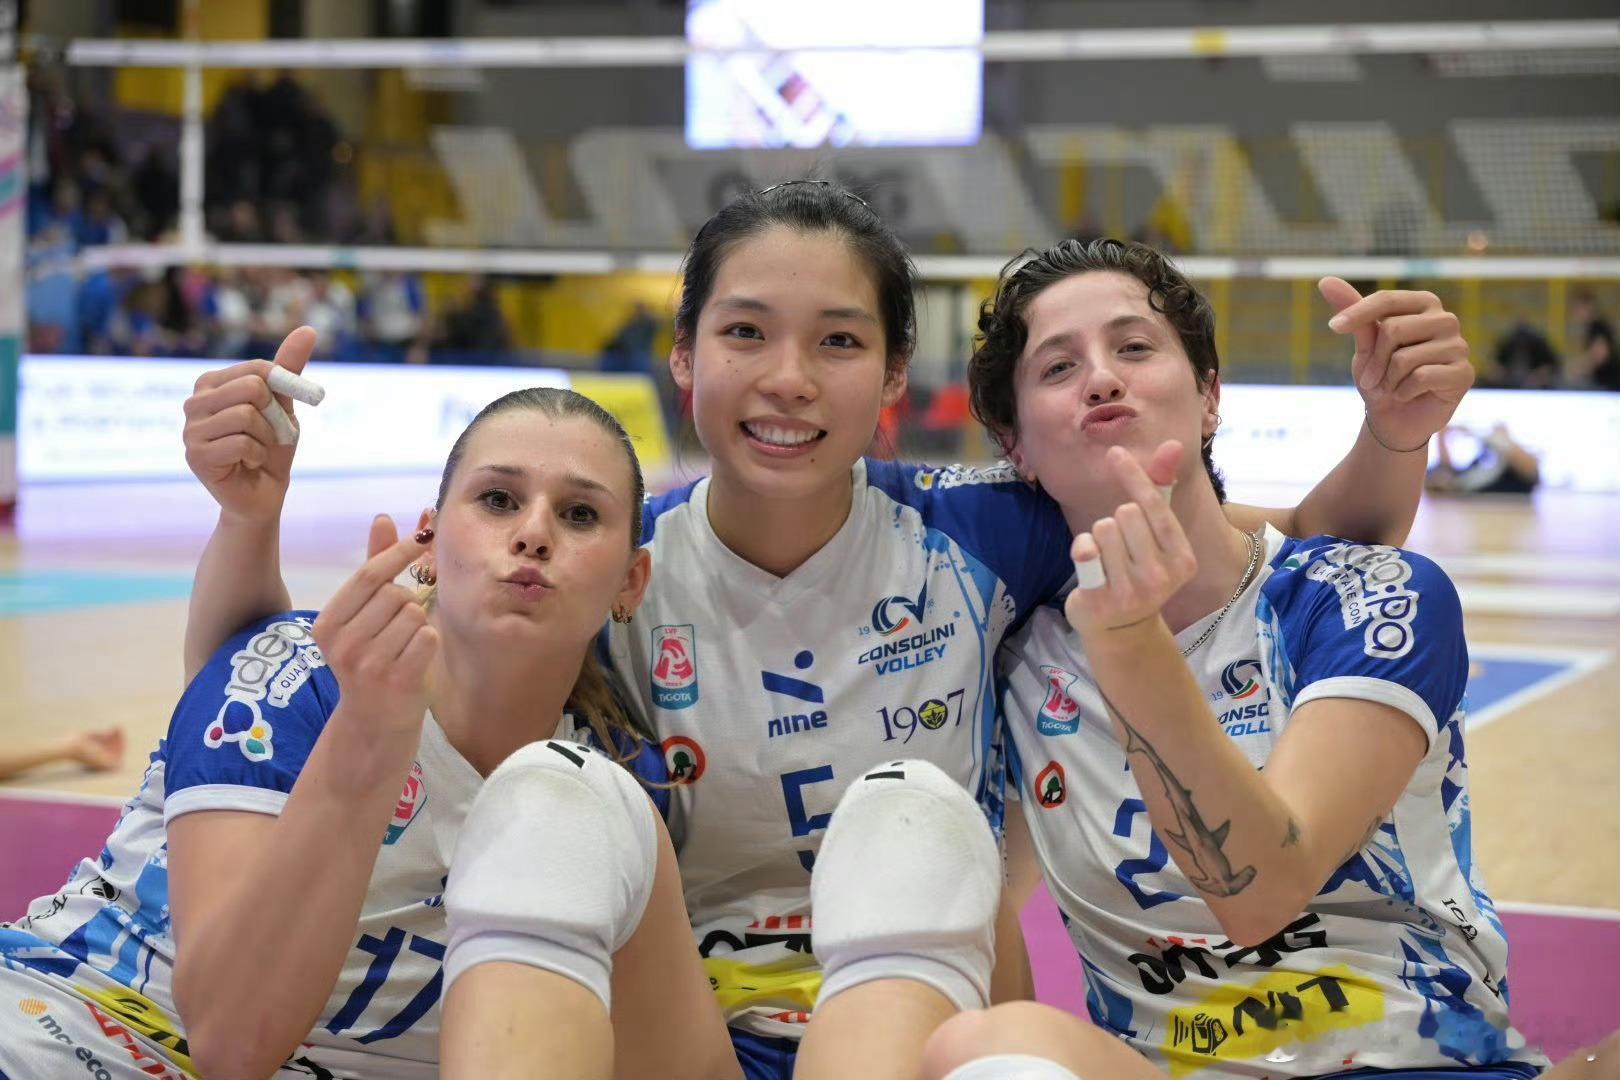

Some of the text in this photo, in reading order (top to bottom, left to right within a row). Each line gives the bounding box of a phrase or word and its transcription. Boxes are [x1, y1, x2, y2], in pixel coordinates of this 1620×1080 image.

[857, 622, 956, 665] CONSOLINI
[875, 643, 947, 676] VOLLEY
[767, 708, 828, 739] nine
[324, 926, 447, 1045] 17
